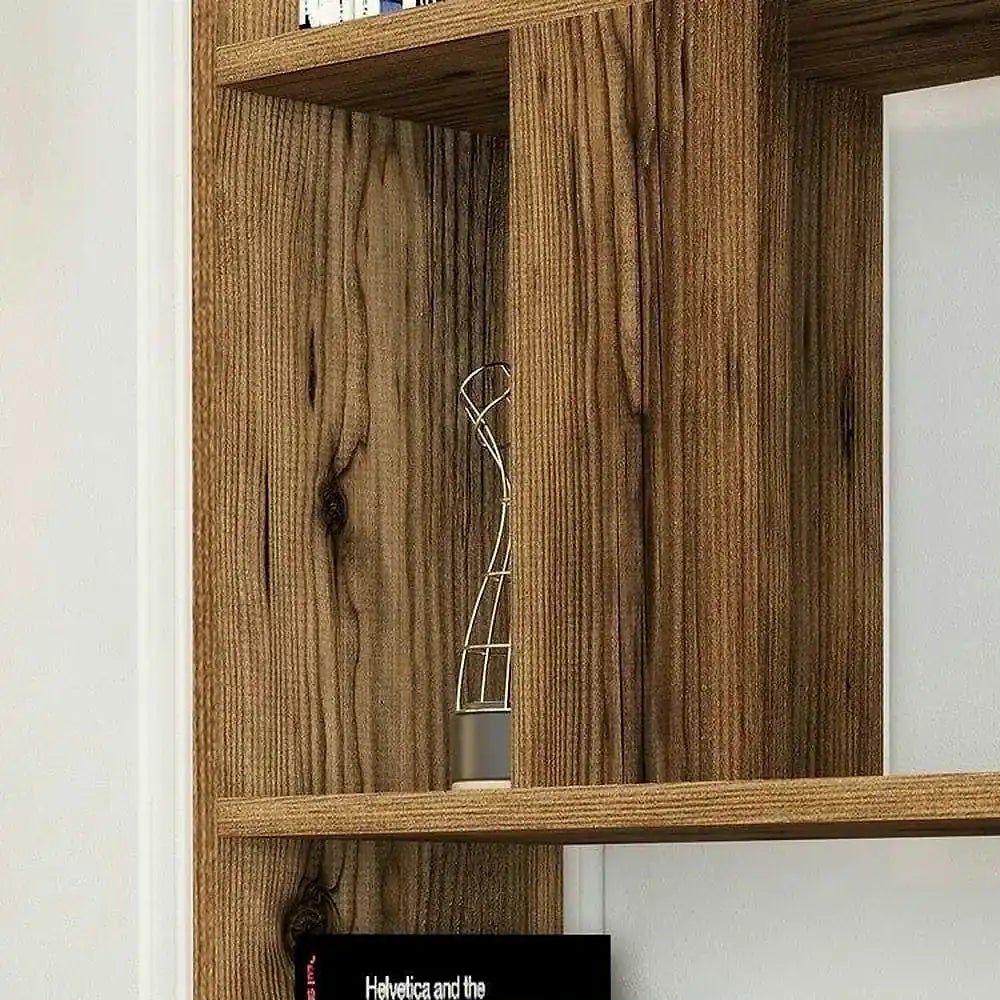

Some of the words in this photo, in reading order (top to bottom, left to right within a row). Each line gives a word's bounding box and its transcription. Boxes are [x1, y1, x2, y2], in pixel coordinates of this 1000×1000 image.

[365, 975, 431, 1000] Helvetica
[434, 975, 460, 1000] and
[463, 974, 486, 999] the
